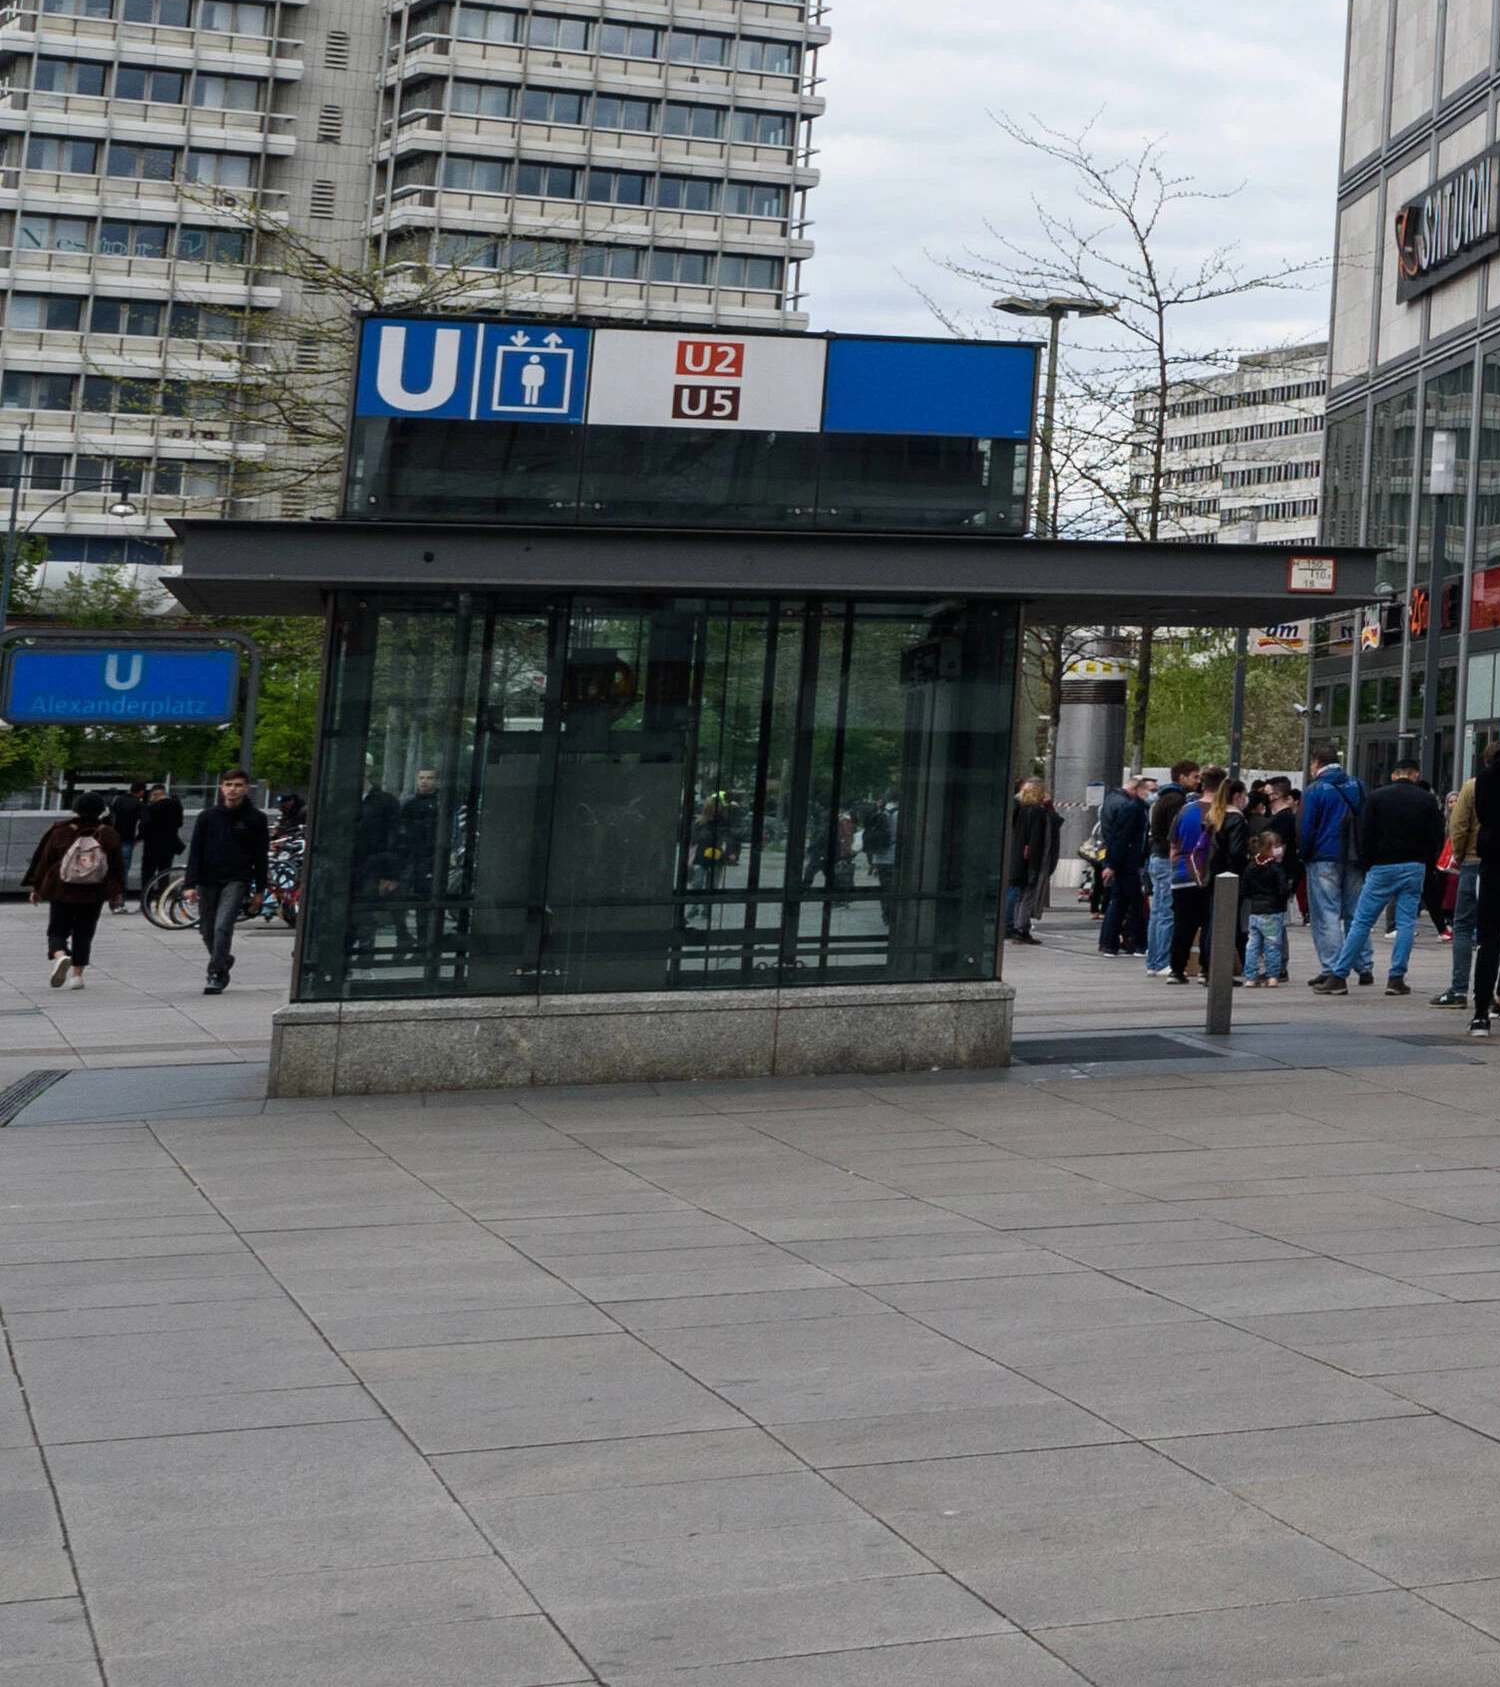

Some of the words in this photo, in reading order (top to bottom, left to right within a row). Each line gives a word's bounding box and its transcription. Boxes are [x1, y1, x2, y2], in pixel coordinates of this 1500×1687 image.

[1420, 155, 1497, 270] SATURN
[376, 326, 461, 412] U
[684, 344, 736, 374] U2
[680, 388, 733, 418] U5
[105, 654, 144, 690] U
[31, 695, 208, 717] Alexanderplatz
